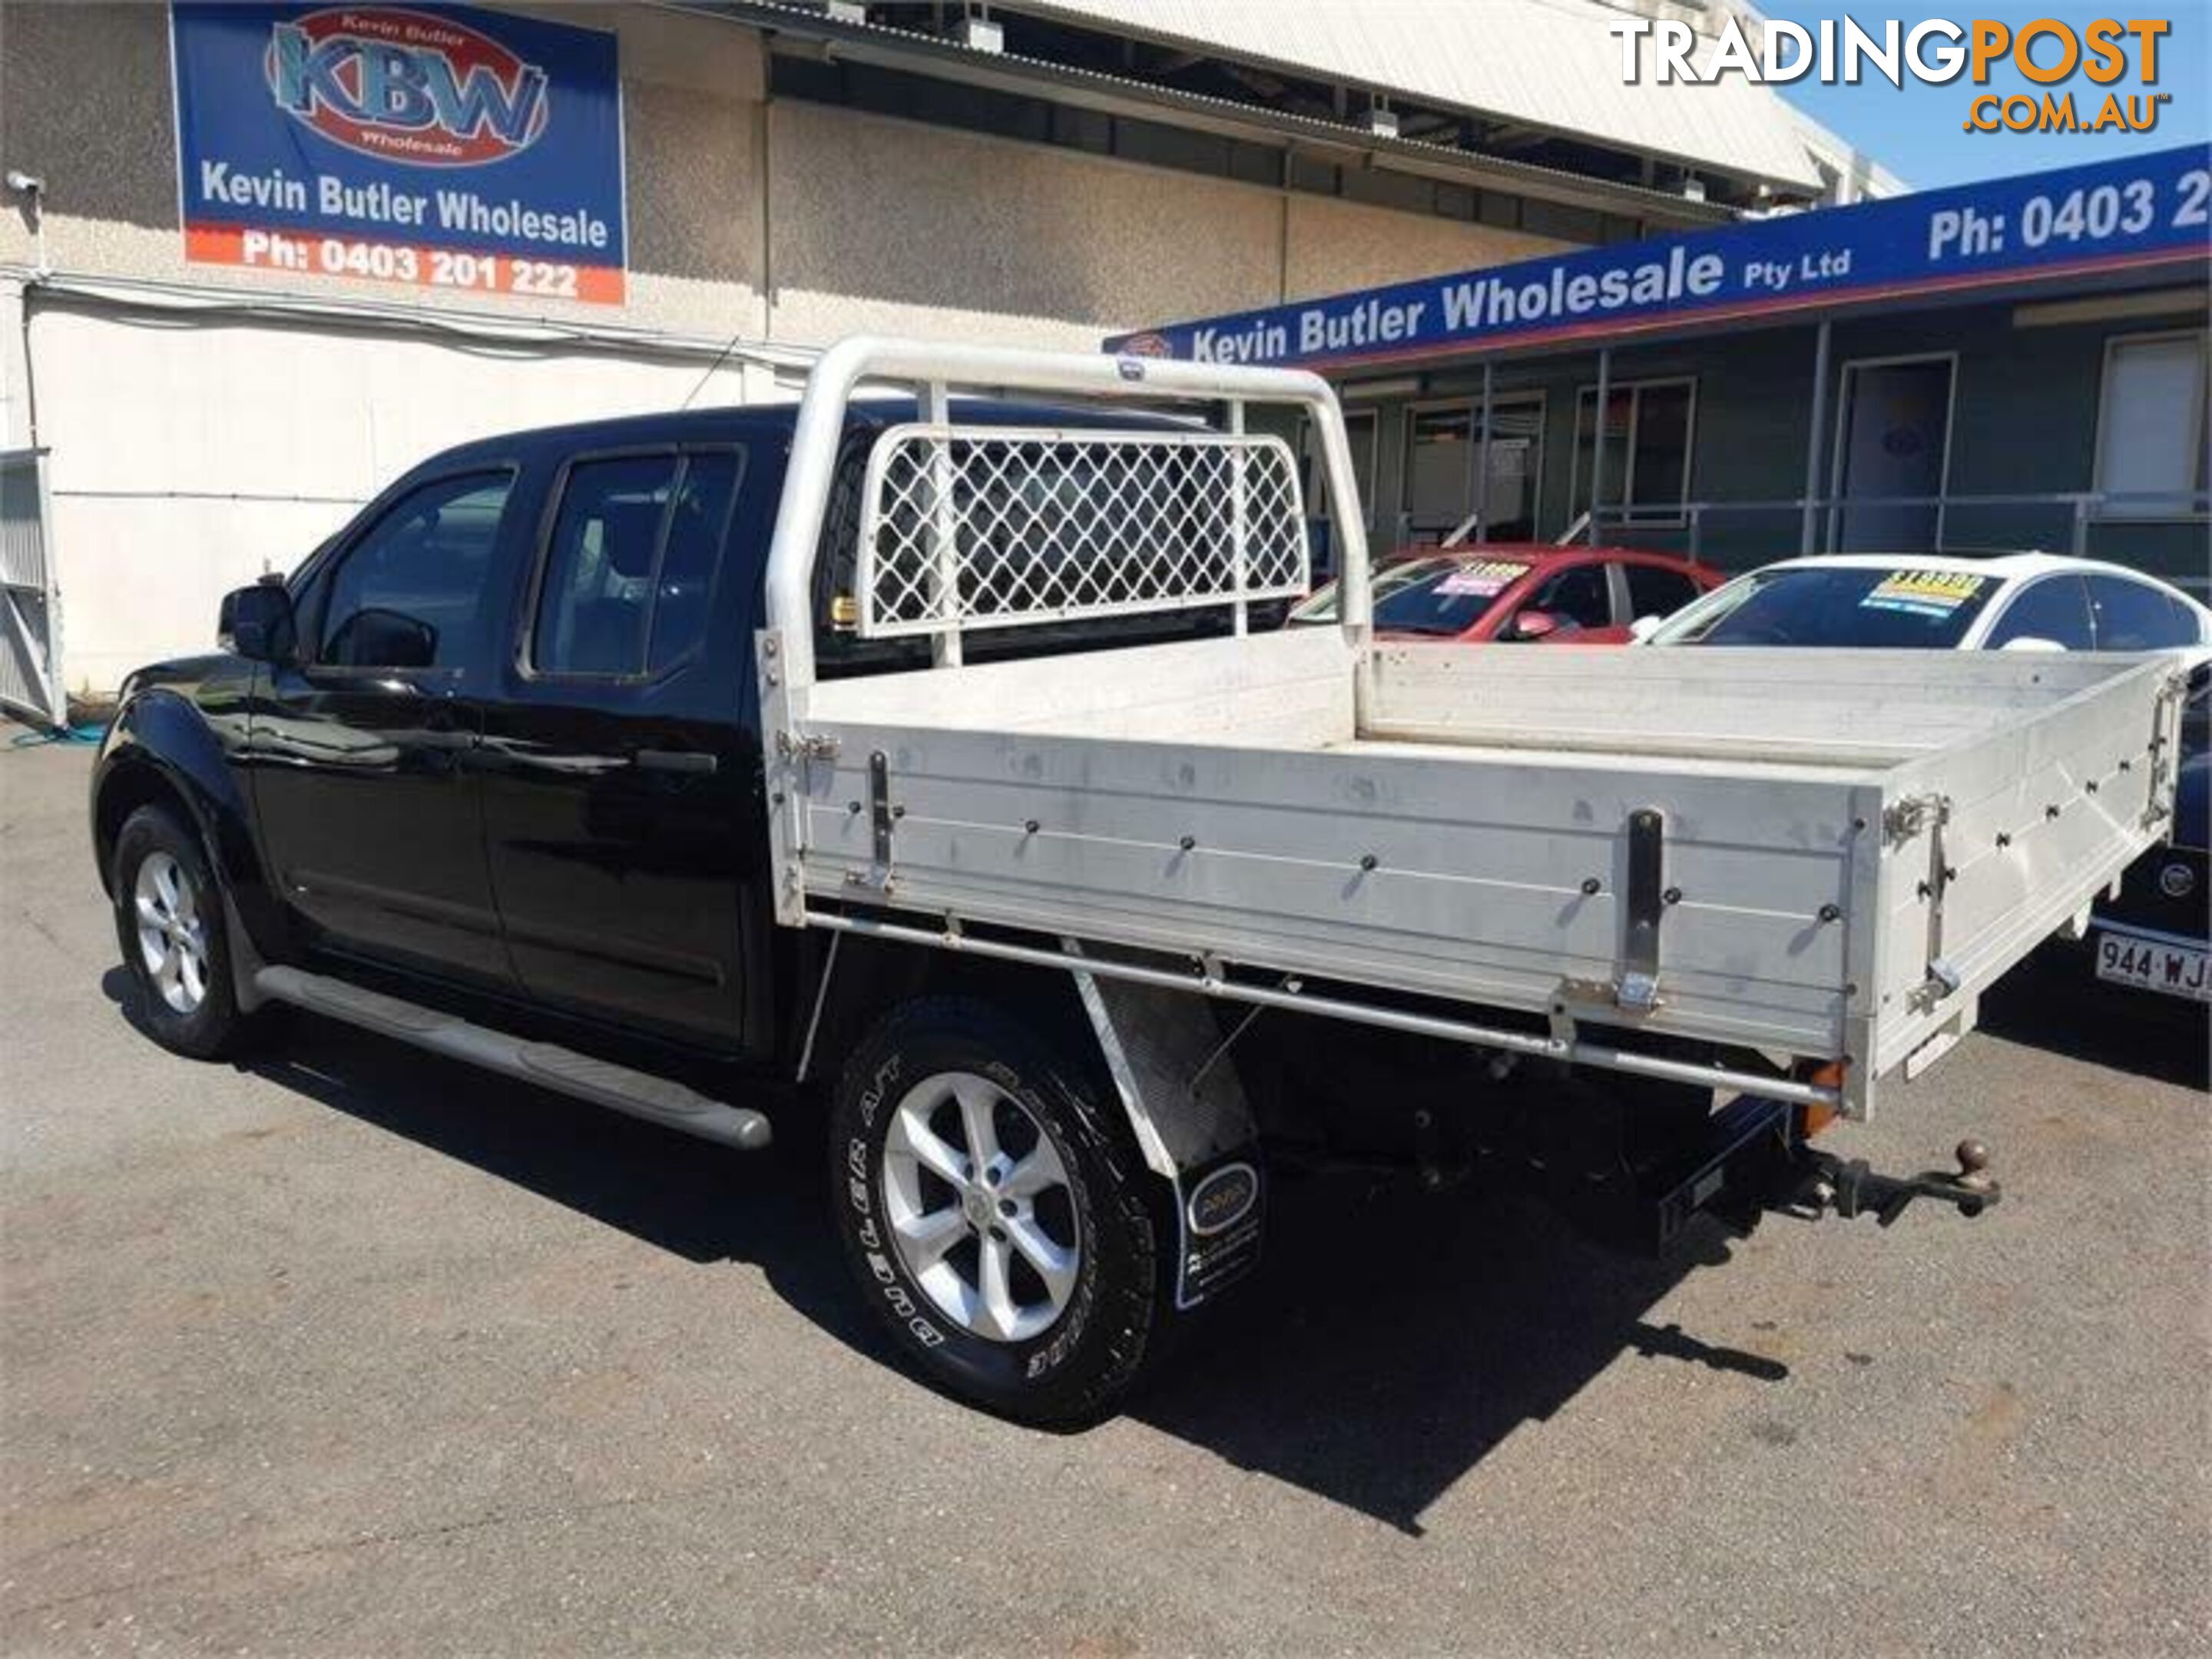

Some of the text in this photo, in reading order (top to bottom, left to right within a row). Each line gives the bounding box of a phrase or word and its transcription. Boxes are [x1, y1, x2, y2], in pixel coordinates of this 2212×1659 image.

[342, 15, 464, 45] Kevin Butler
[273, 22, 548, 147] KBW
[201, 160, 608, 249] Kevin Butler Wholesale
[243, 230, 578, 298] Ph: 0403 201 222
[1193, 319, 1286, 364] Kevin
[1300, 300, 1425, 353] Butler
[1442, 247, 1724, 330] Wholesale
[1744, 262, 1792, 292] Pty
[1802, 249, 1851, 280] Ltd
[1929, 207, 2005, 260] Ph:
[2022, 179, 2154, 247] 0403
[2104, 942, 2152, 977] 944
[2164, 952, 2212, 988] WJ
